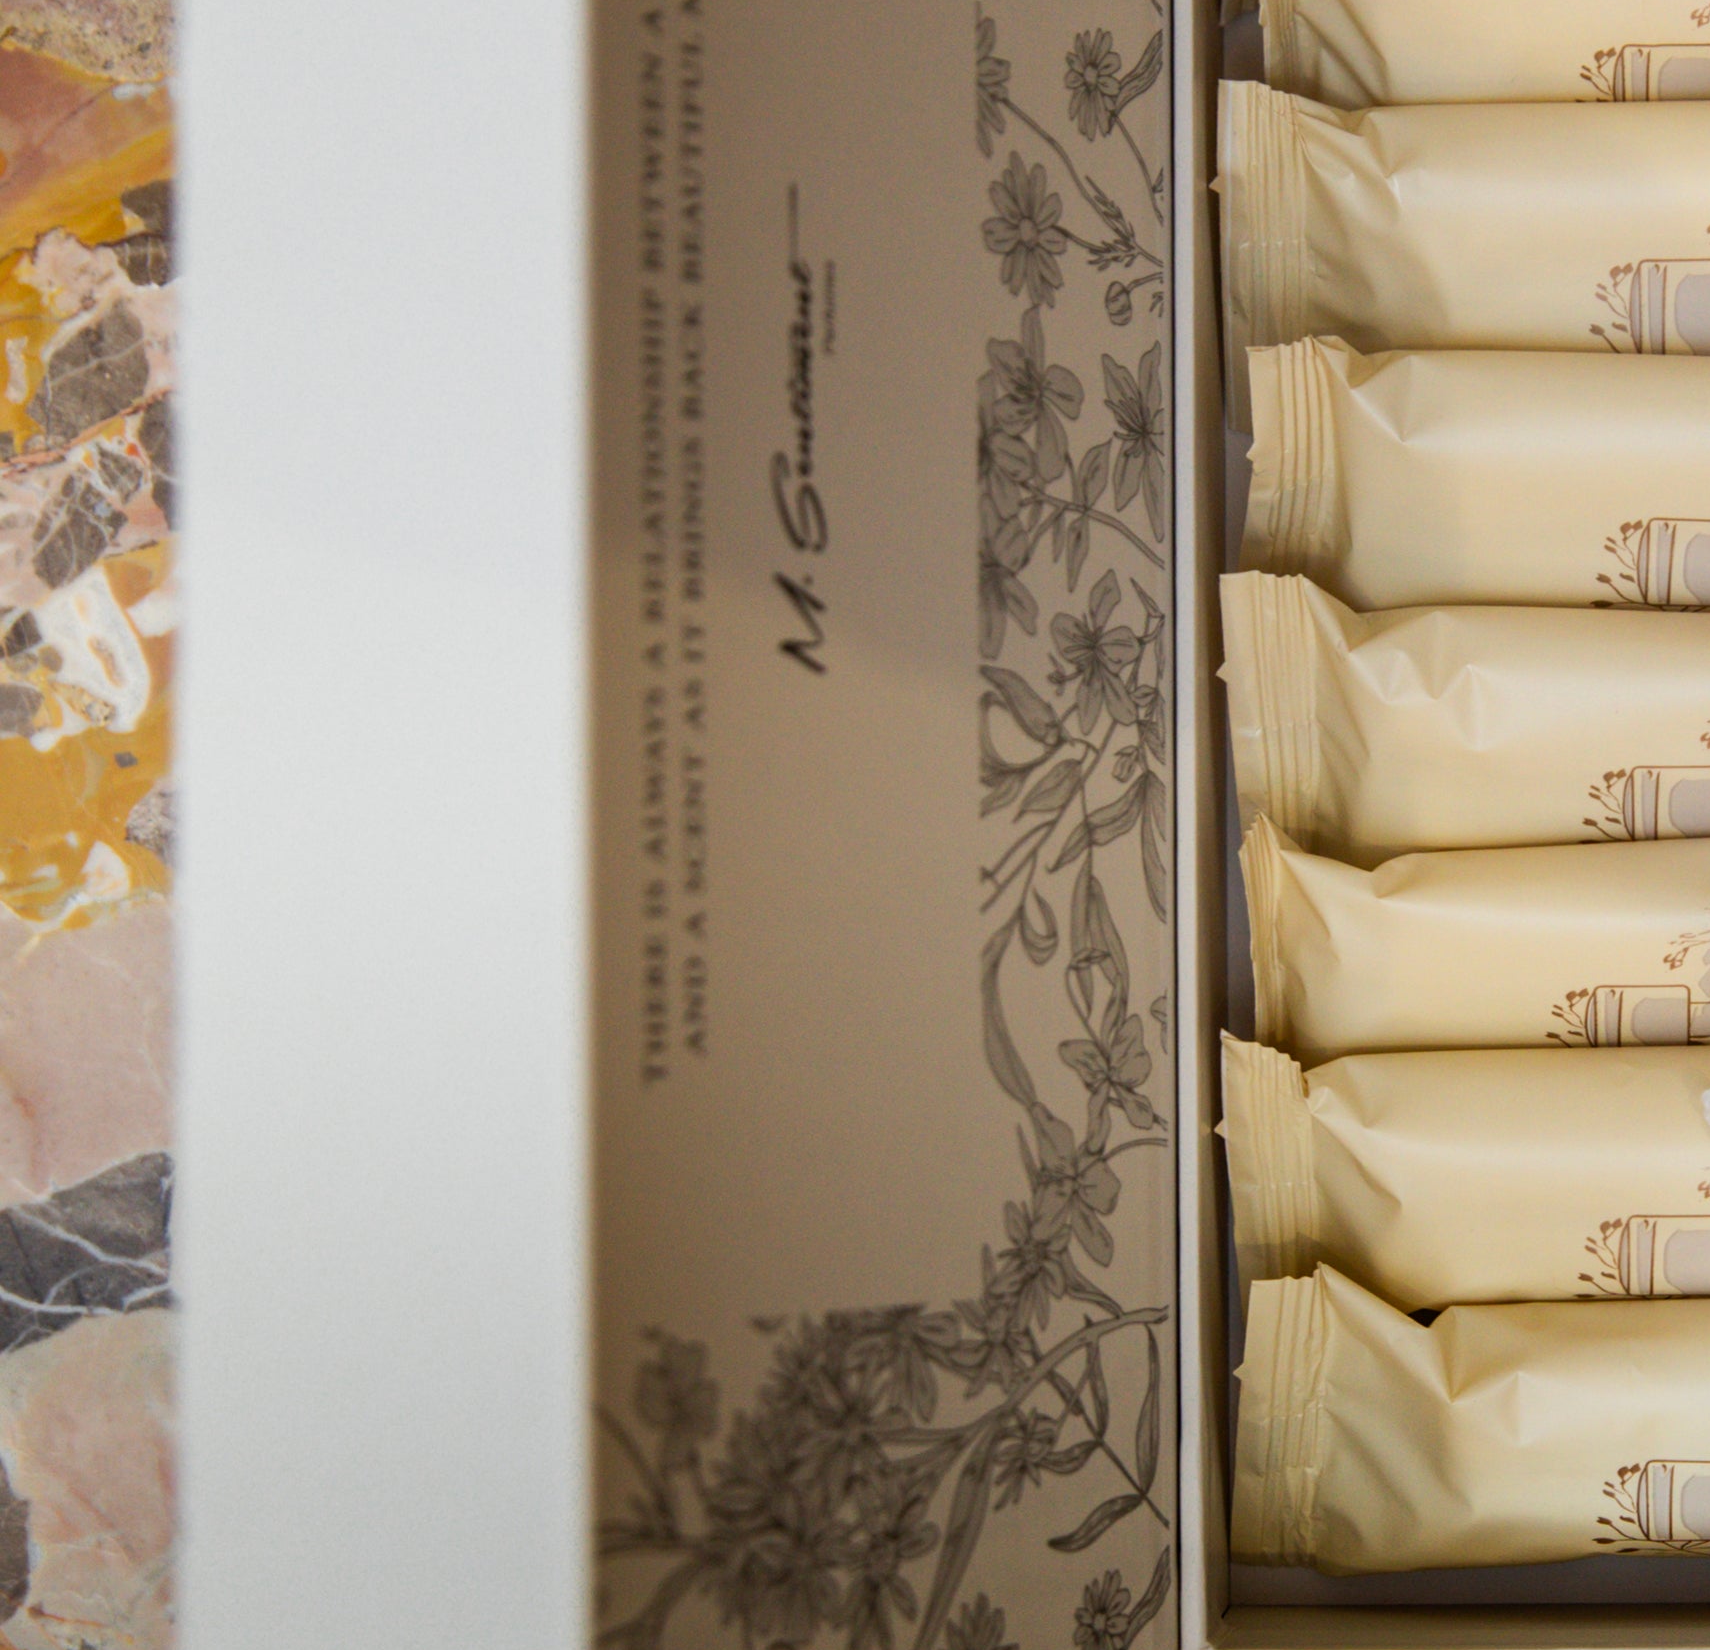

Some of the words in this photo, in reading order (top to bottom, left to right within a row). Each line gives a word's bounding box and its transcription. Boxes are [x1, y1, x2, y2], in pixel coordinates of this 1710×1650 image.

[639, 8, 664, 35] A
[639, 47, 665, 272] BETWEEN
[680, 33, 703, 287] BEAUTIFUL
[680, 304, 704, 422] BACK
[640, 288, 667, 625] RELATIONSHIP
[681, 435, 705, 605] BRINGS
[642, 642, 667, 670] A
[642, 686, 667, 864] ALWAYS
[642, 880, 667, 920] IS
[683, 911, 706, 942] A
[641, 937, 668, 1088] THERE
[683, 955, 706, 1056] AND
